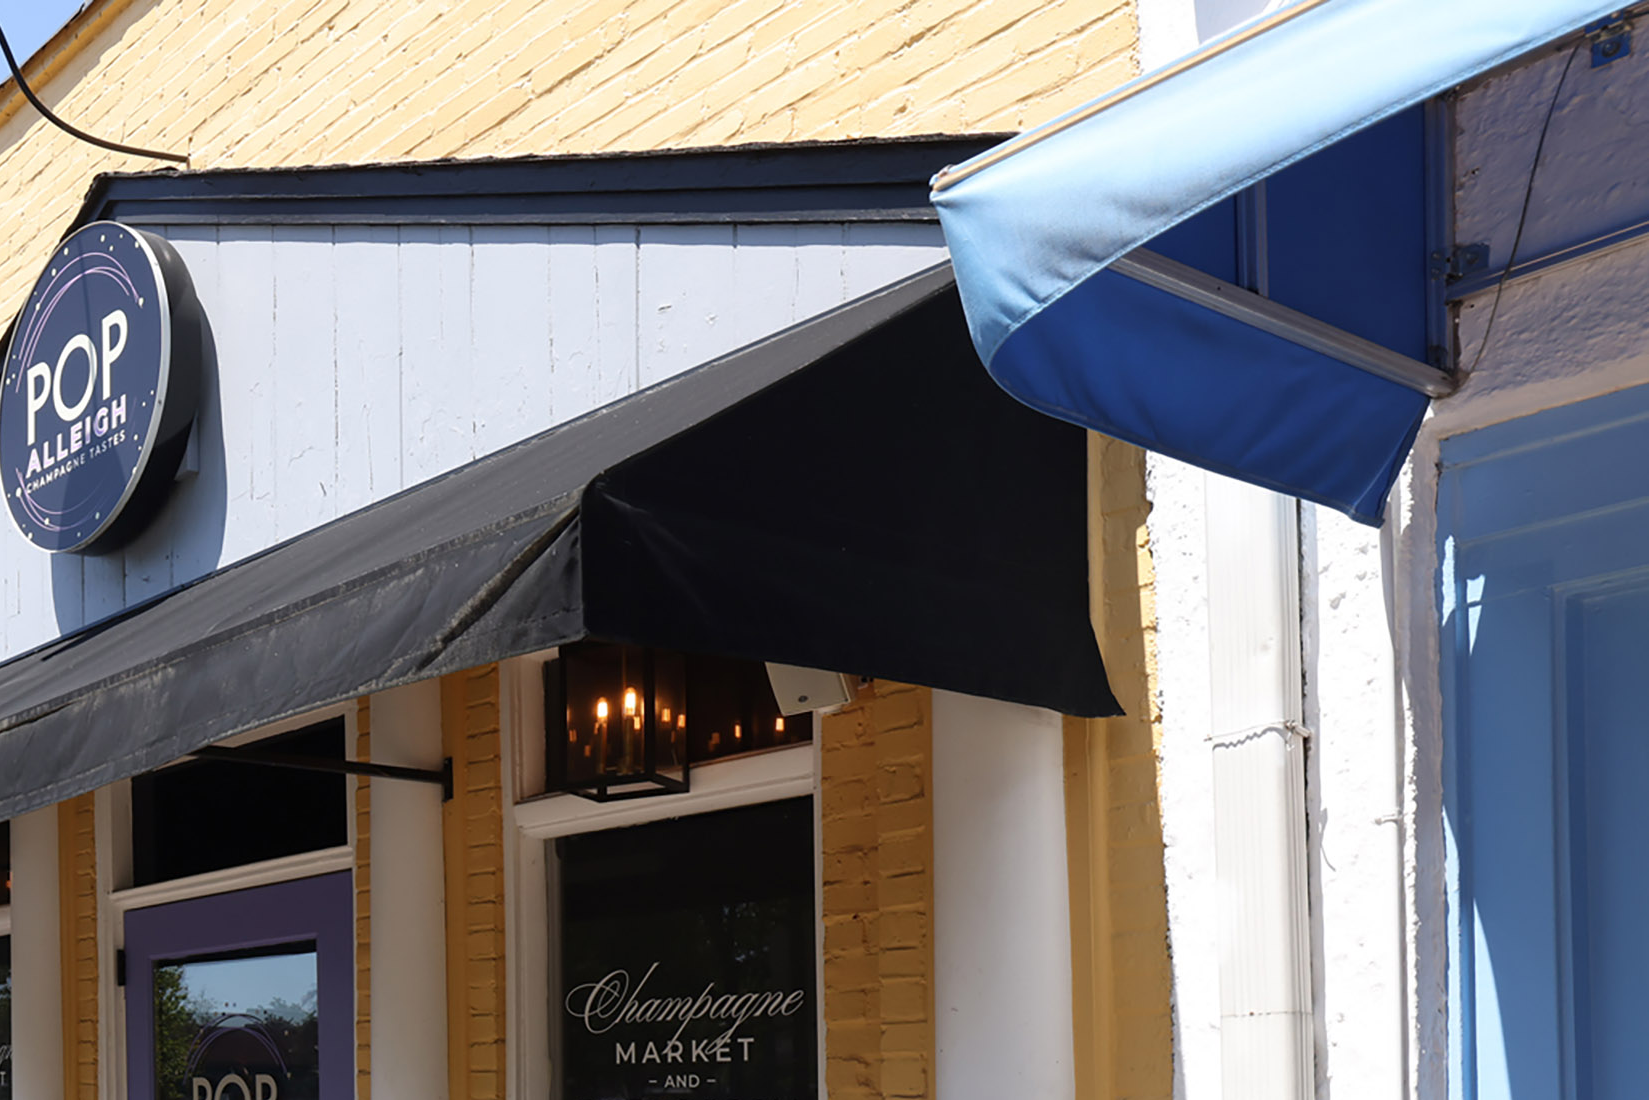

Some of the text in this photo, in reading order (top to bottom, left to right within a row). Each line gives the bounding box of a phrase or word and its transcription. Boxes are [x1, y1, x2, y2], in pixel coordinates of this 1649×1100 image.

[27, 309, 128, 446] POP
[26, 394, 127, 478] ALLEIGH
[26, 430, 126, 494] CHAMPAGNE TASTES
[565, 961, 804, 1056] Champagne
[615, 1037, 755, 1064] MARKET
[664, 1075, 700, 1088] AND
